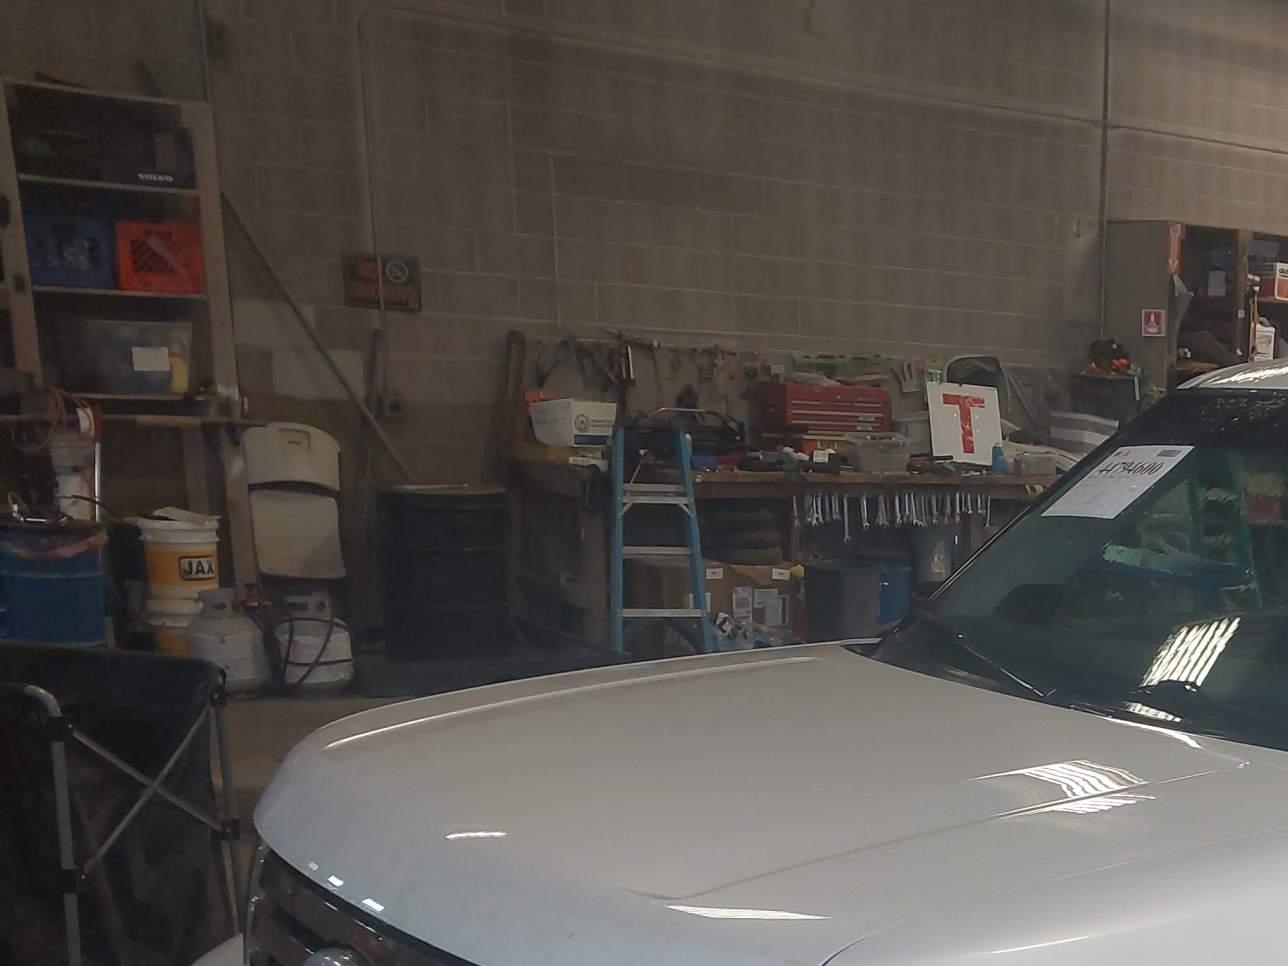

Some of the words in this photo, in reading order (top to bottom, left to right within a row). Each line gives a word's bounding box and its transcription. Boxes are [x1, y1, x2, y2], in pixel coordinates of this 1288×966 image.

[137, 173, 174, 183] VOLVO
[943, 393, 985, 454] T
[183, 559, 214, 576] JAX
